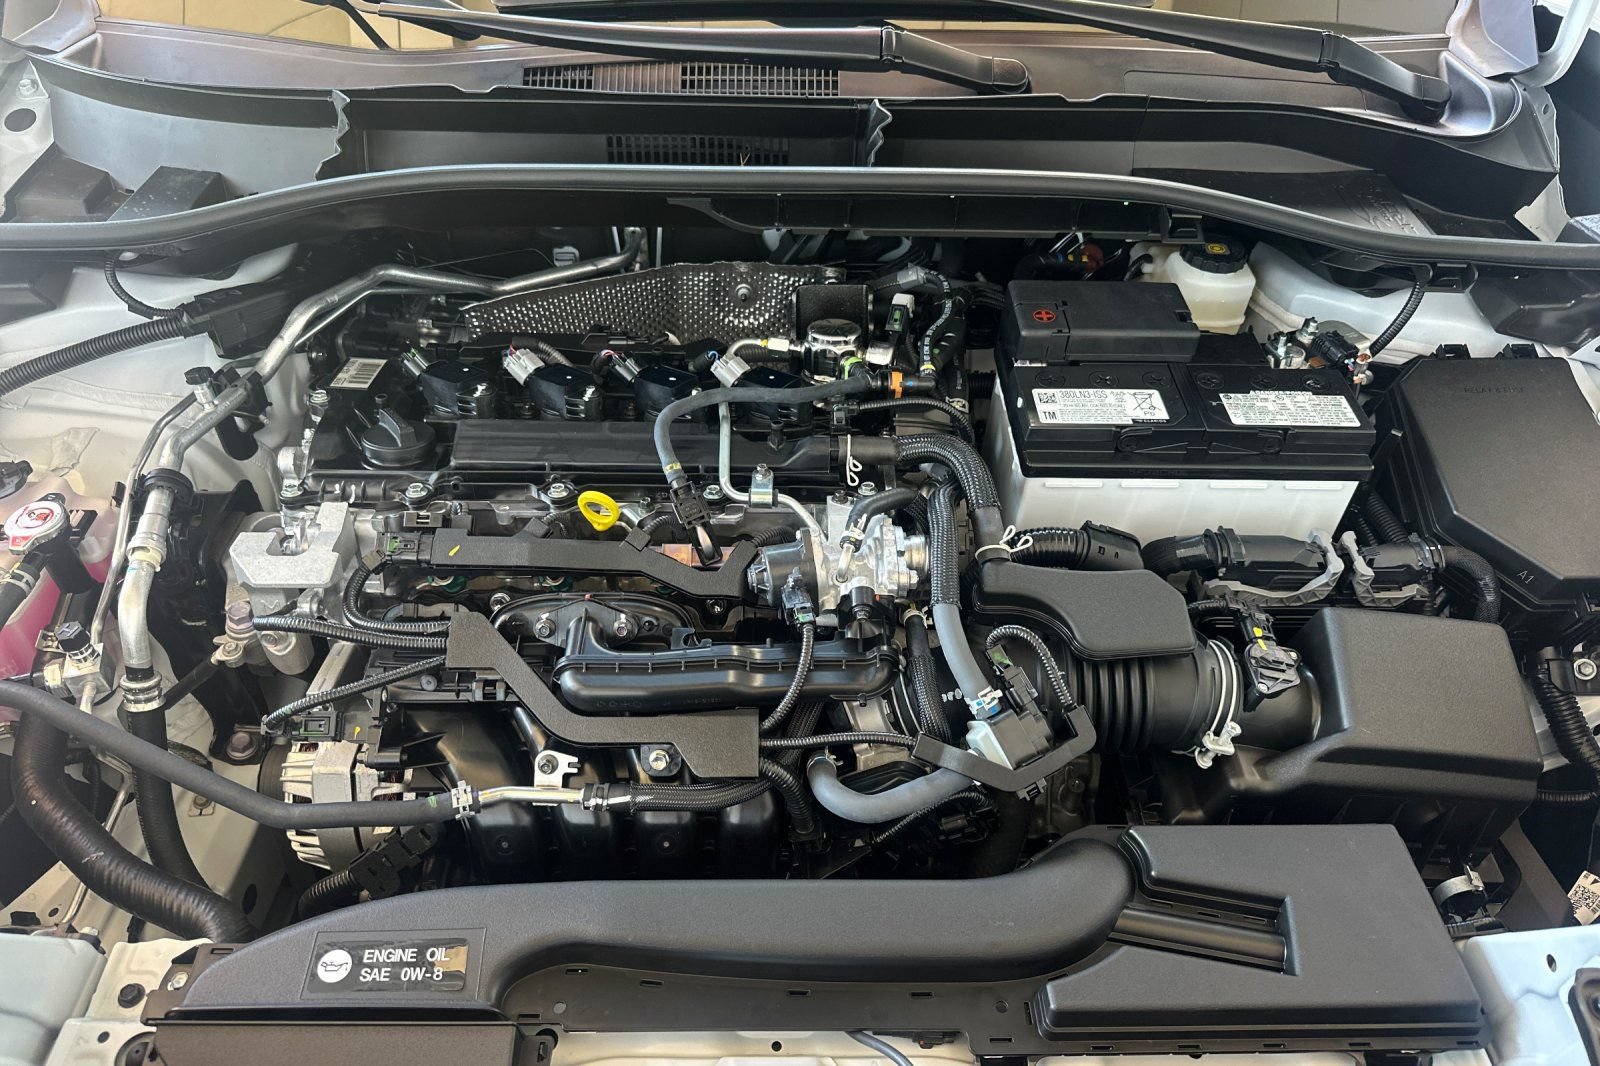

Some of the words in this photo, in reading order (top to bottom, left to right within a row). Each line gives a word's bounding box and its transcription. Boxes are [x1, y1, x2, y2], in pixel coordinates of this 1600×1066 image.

[1059, 390, 1108, 399] 380LN3-ISS
[1042, 411, 1057, 420] TM
[1516, 570, 1535, 584] A1
[363, 948, 418, 963] ENGINE
[426, 947, 450, 962] OIL
[359, 967, 391, 982] SAE
[400, 967, 443, 982] 0W-8
